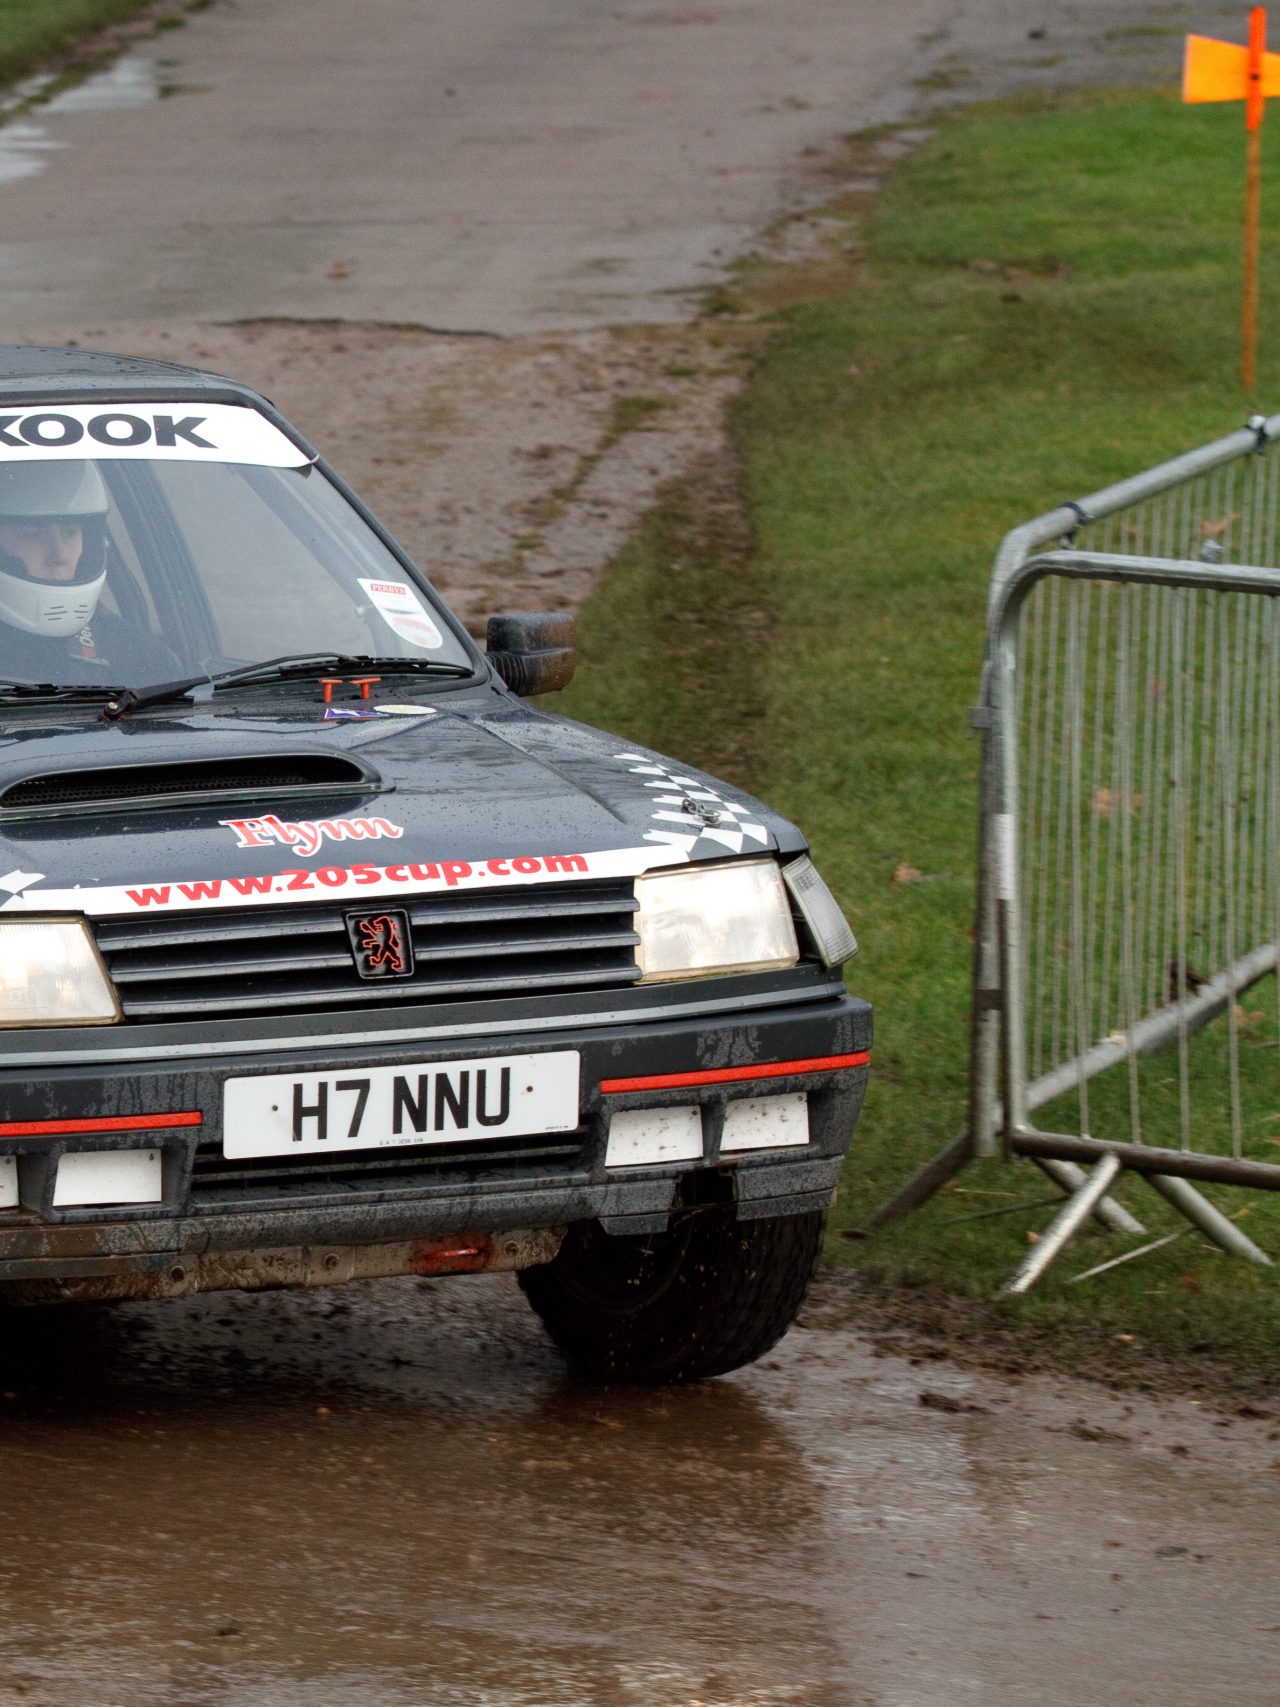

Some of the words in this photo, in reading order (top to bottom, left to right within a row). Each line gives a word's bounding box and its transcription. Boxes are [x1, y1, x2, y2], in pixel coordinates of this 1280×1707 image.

[218, 814, 404, 857] Flynn
[126, 853, 589, 907] www.205cup.com
[292, 1078, 370, 1142] H7
[393, 1067, 510, 1134] NNU
